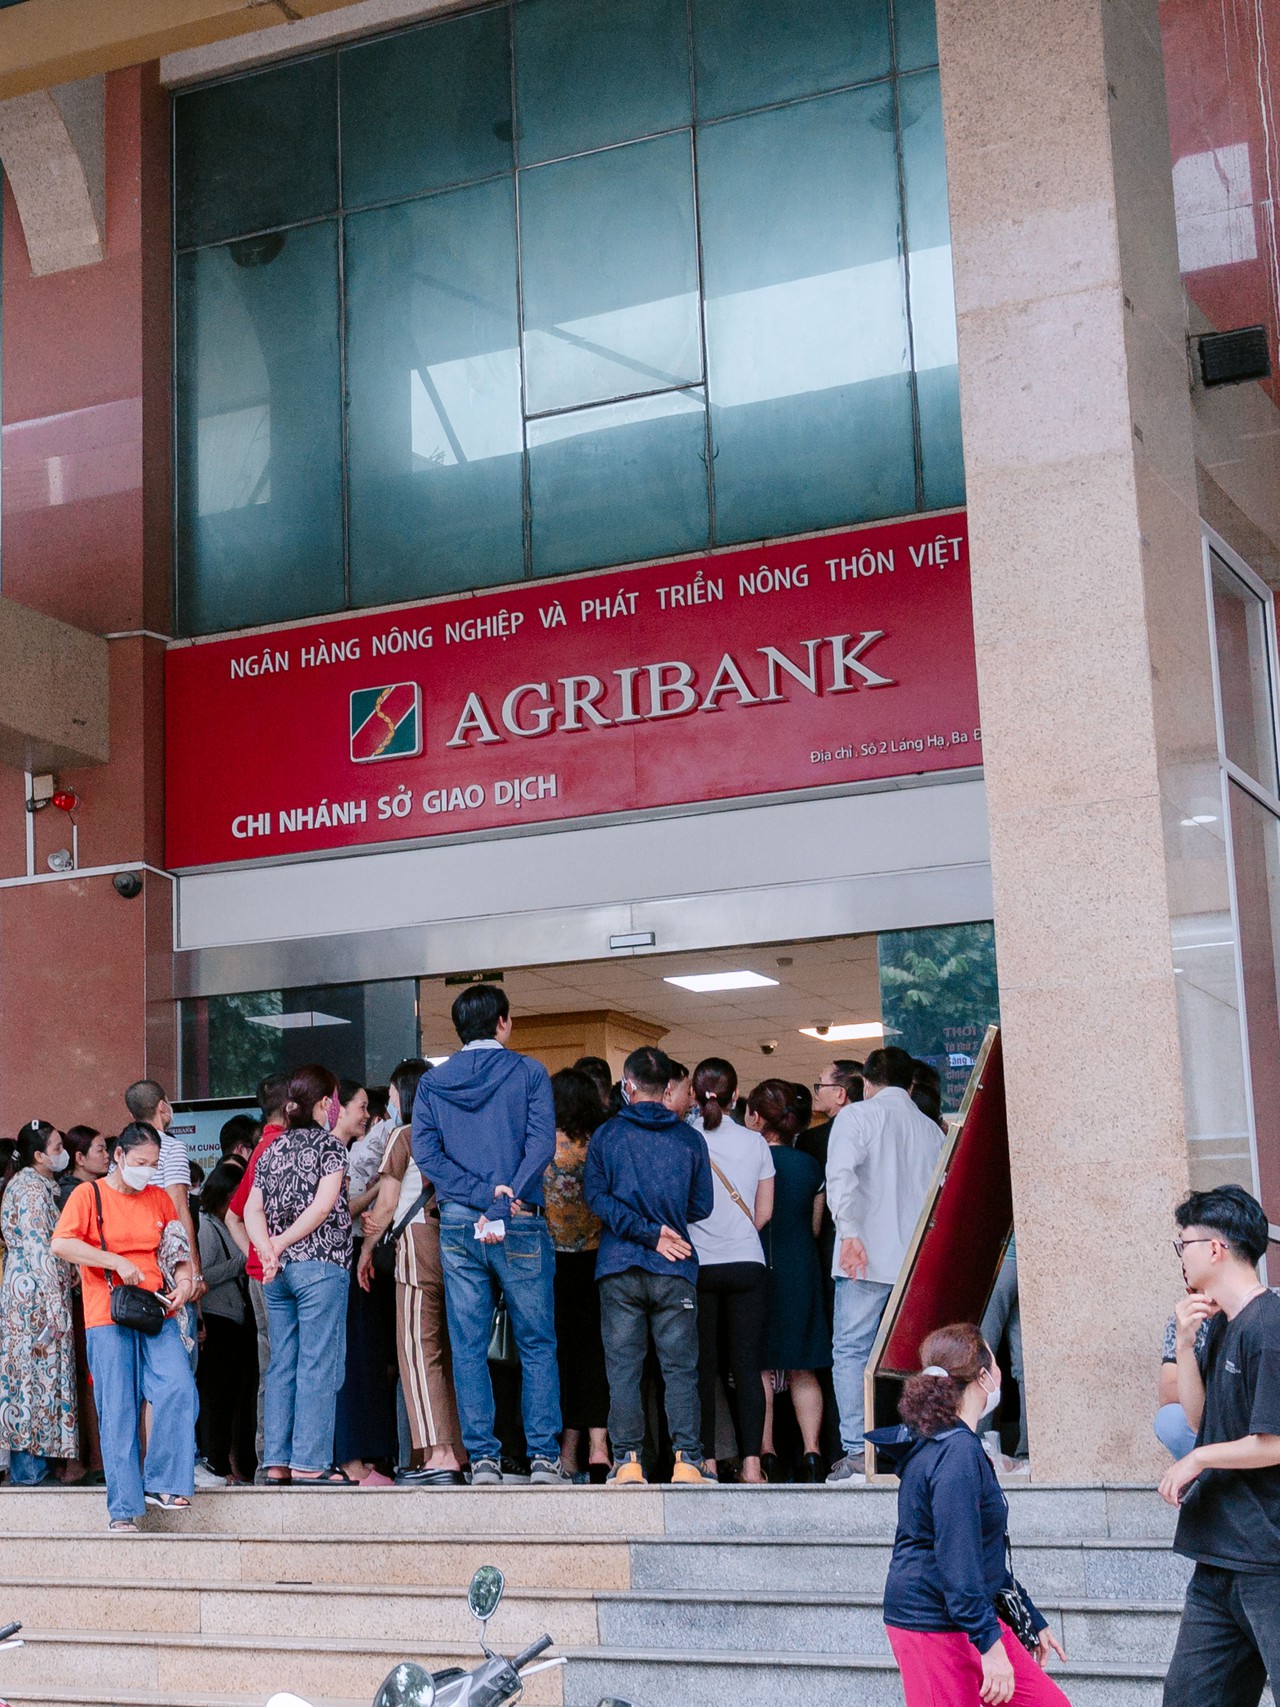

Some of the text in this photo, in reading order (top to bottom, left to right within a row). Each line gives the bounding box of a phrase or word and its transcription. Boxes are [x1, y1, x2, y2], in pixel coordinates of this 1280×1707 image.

[230, 534, 963, 679] NGÂN HÀNG NÔNG NGHIỆP VÀ PHÁT TRIỂN NÔNG THÔN VIỆT
[445, 630, 895, 748] AGRIBANK
[810, 749, 831, 765] Địa
[880, 741, 888, 754] 2
[891, 738, 923, 753] Láng
[952, 731, 968, 744] Ba
[231, 774, 557, 838] CHI NHÁNH SỞ GIAO DỊCH
